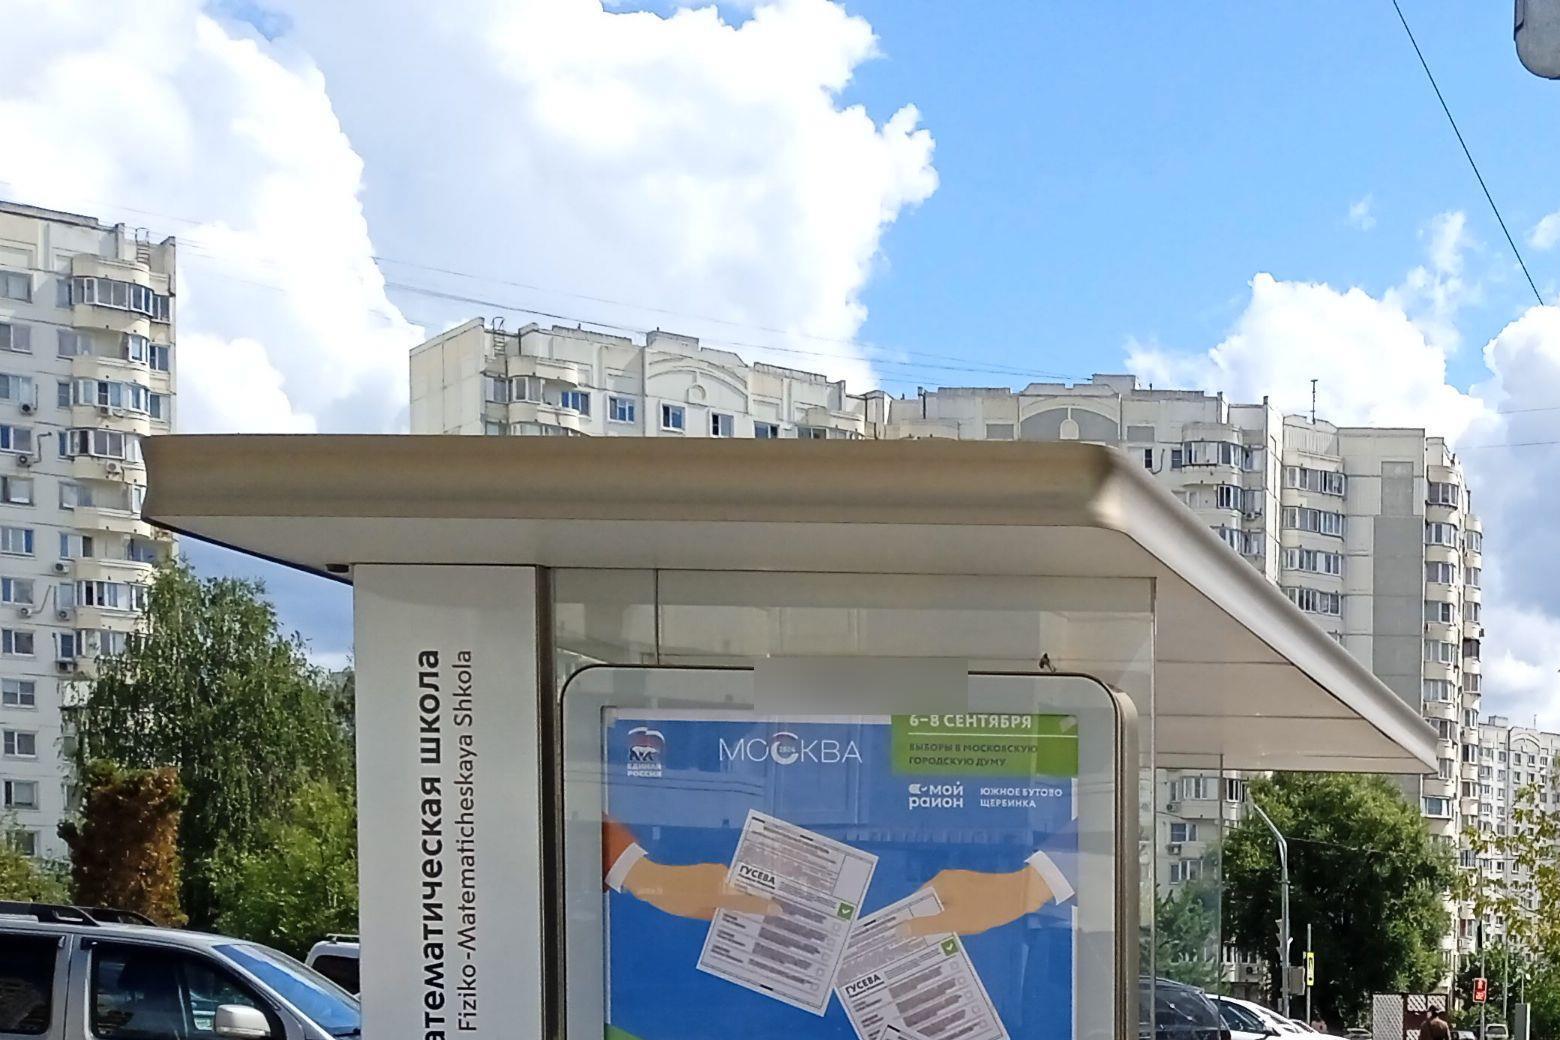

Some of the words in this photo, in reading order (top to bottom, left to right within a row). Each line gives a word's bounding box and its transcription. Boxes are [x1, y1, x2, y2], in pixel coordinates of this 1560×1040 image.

[452, 650, 473, 727] Shkola
[418, 650, 441, 764] школа
[943, 714, 1032, 729] СЕНТЯБРЯ
[719, 731, 863, 766] МОСКВА
[963, 744, 1038, 754] МОСКОВСКУЮ
[909, 756, 974, 766] ГОРОДСКУЮ
[976, 758, 1007, 767] ДУМУ
[980, 787, 1021, 797] ЮЖНОЕ
[1022, 788, 1064, 797] БУТОВО
[980, 798, 1037, 809] ЩЕРБИНКА
[453, 734, 478, 1031] Fiziko-Matematicheskaya
[739, 864, 777, 886] ГУСЕВА
[844, 973, 882, 996] ГУСЕВА
